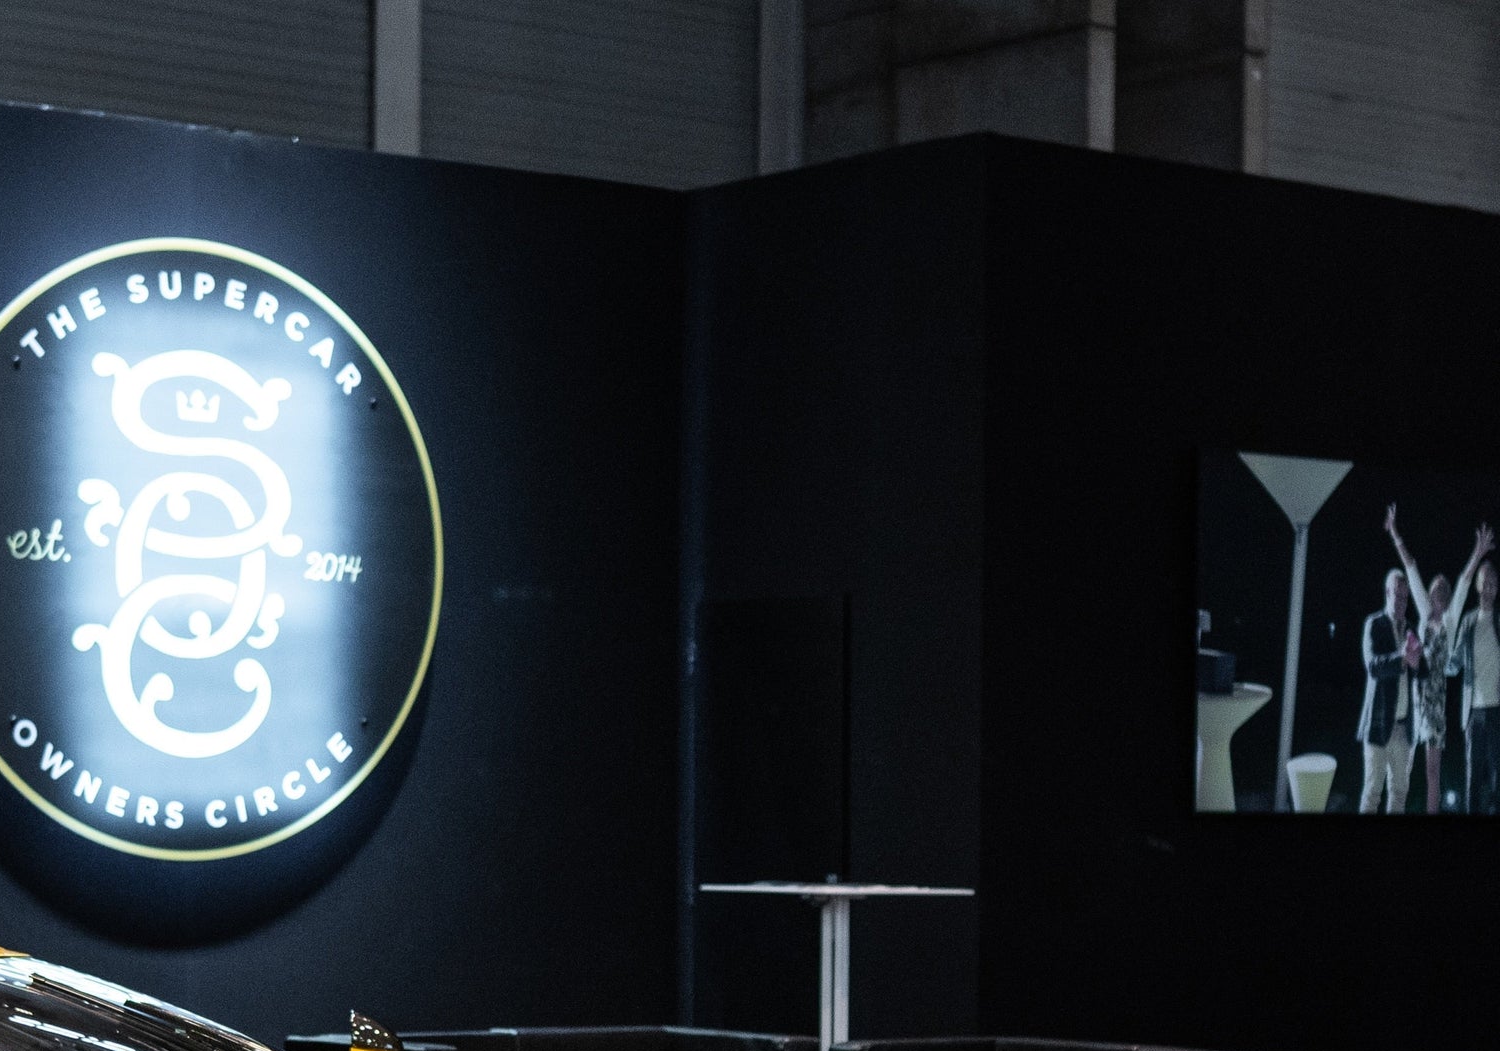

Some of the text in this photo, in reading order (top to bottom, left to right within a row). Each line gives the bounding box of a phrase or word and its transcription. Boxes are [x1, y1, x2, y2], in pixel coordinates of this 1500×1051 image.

[20, 271, 362, 394] THE SUPERCAR
[6, 519, 362, 583] est. 2014
[12, 718, 352, 829] OWNERS CIRCLE
